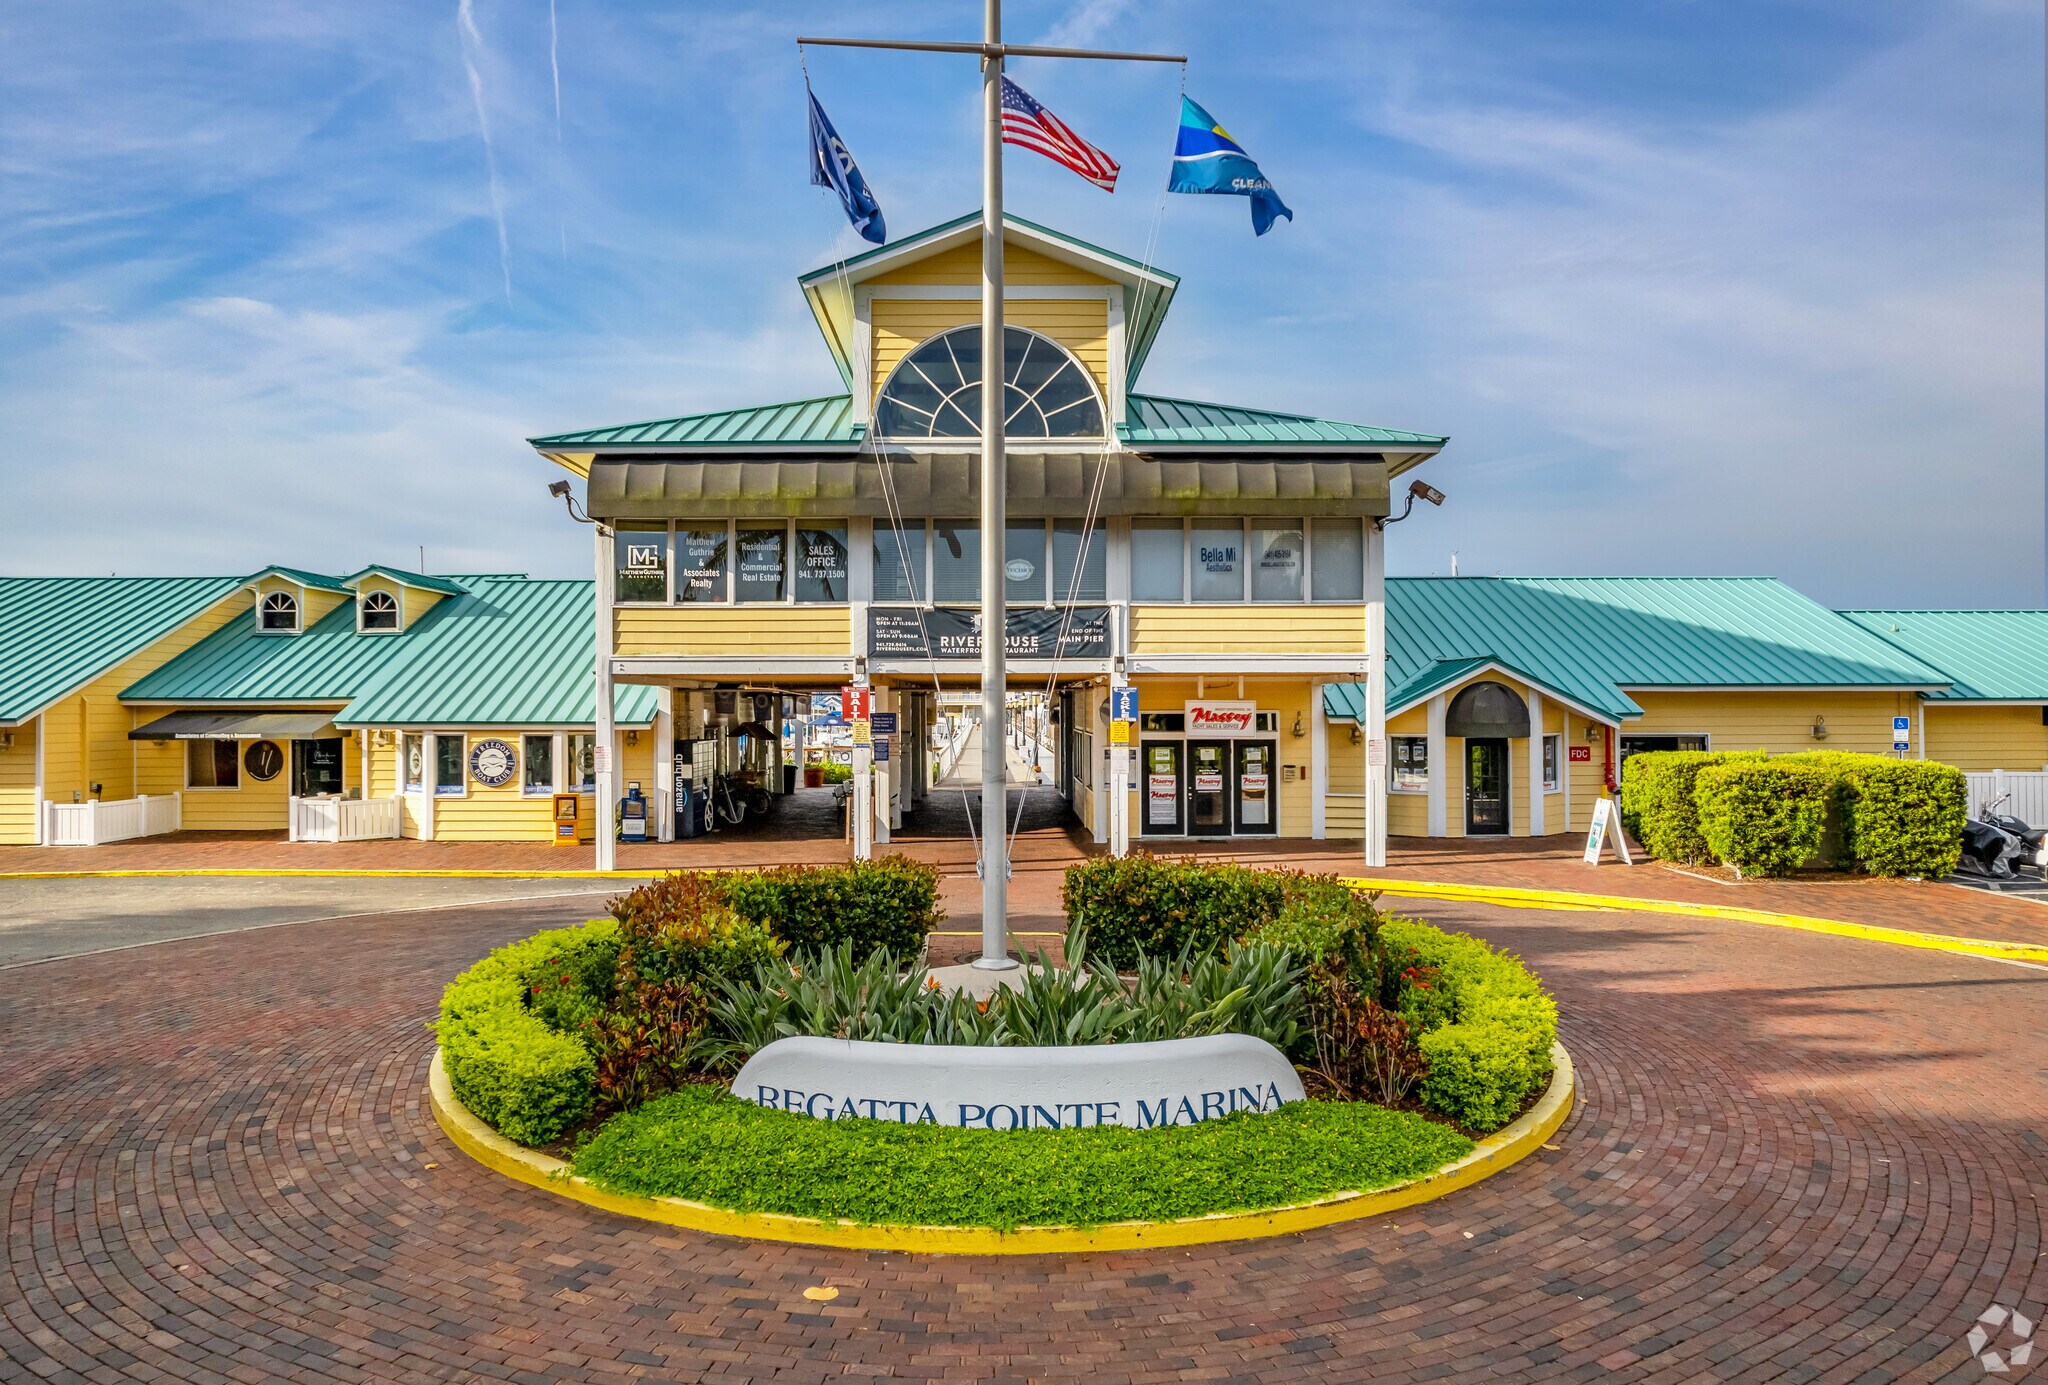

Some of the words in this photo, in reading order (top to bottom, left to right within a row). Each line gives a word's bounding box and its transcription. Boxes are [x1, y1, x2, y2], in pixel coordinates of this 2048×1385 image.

[1231, 177, 1272, 190] CLEAN
[686, 538, 716, 546] Matthew
[741, 542, 781, 551] Residential
[688, 548, 715, 557] Guthrie
[808, 545, 835, 556] SALES
[1200, 547, 1224, 562] Bella
[1225, 547, 1237, 562] Mi
[757, 552, 764, 561] &
[806, 557, 837, 567] OFFICE
[698, 558, 705, 567] &
[740, 563, 783, 572] Commercial
[1205, 562, 1233, 572] Aesthetics
[682, 568, 720, 577] Associates
[742, 573, 758, 582] Real
[759, 573, 781, 582] Estate
[690, 578, 713, 589] Realty
[850, 691, 861, 719] BAIT
[1120, 691, 1131, 719] TACKLE
[1190, 707, 1252, 730] Massey
[475, 742, 511, 757] FREEDOM
[1571, 749, 1588, 758] FDC
[674, 753, 683, 774] hub
[474, 768, 492, 783] BOAT
[493, 769, 511, 783] CLUB
[675, 776, 683, 813] amazon
[757, 1085, 938, 1124] REGATTA
[958, 1101, 1121, 1130] POINTE
[1136, 1081, 1283, 1130] MARINA
